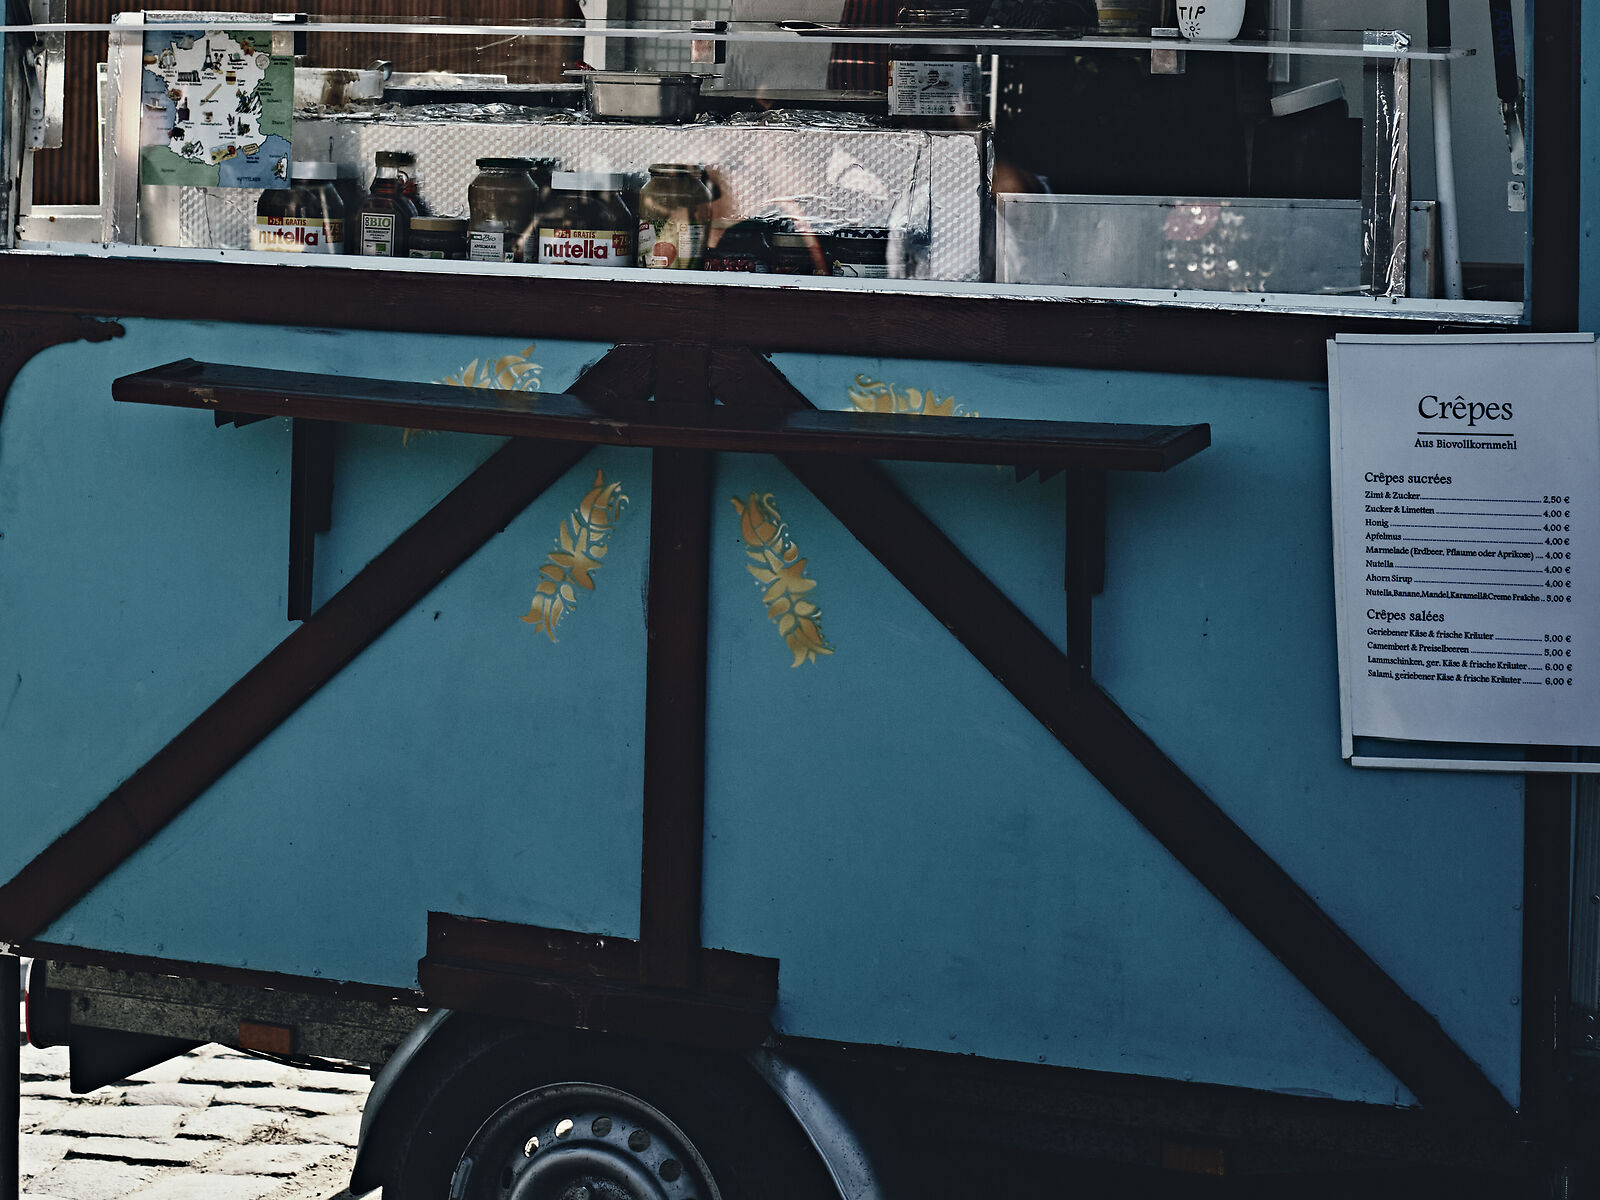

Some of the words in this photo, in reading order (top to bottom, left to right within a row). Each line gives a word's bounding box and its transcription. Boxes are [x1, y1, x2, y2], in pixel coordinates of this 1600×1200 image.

[1179, 6, 1206, 20] TIP
[286, 218, 306, 226] GRATIS
[370, 218, 391, 228] BIO
[258, 227, 318, 246] nutella
[544, 240, 608, 259] nutella
[1418, 395, 1513, 426] Crêpes
[1414, 438, 1434, 448] Aus
[1436, 439, 1517, 450] Biovollkornmehl
[1364, 472, 1404, 486] Crêpes
[1408, 474, 1452, 484] sucrées
[1364, 490, 1384, 498] Zimt
[1392, 492, 1420, 500] Zucker
[1564, 496, 1570, 504] €
[1365, 504, 1392, 512] Zucker
[1402, 506, 1434, 514] Limetten
[1564, 510, 1570, 518] €
[1365, 518, 1388, 528] Honig
[1564, 524, 1570, 532] €
[1366, 532, 1402, 541] Apfelmus
[1366, 546, 1409, 554] Marmelade
[1410, 548, 1444, 557] (Erdbeer,
[1446, 548, 1477, 557] Pflaume
[1497, 550, 1534, 561] Aprikose)
[1366, 560, 1393, 568] Nutella
[1392, 575, 1412, 584] Sirup
[1367, 608, 1406, 623] Crêpes
[1410, 611, 1444, 622] salées
[1367, 628, 1408, 636] Geriebener
[1409, 629, 1427, 637] Käse
[1436, 630, 1462, 638] frische
[1464, 632, 1494, 640] Kräuter
[1367, 642, 1409, 650] Camembert
[1419, 644, 1469, 653] Preiselbeeren
[1544, 649, 1563, 657] 5,00
[1462, 660, 1468, 668] &
[1469, 660, 1496, 668] frische
[1497, 662, 1527, 670] Kräuter
[1368, 670, 1393, 679] Salami,
[1395, 670, 1435, 680] geriebener
[1491, 676, 1521, 684] Kräuter
[1545, 678, 1564, 686] 6,00
